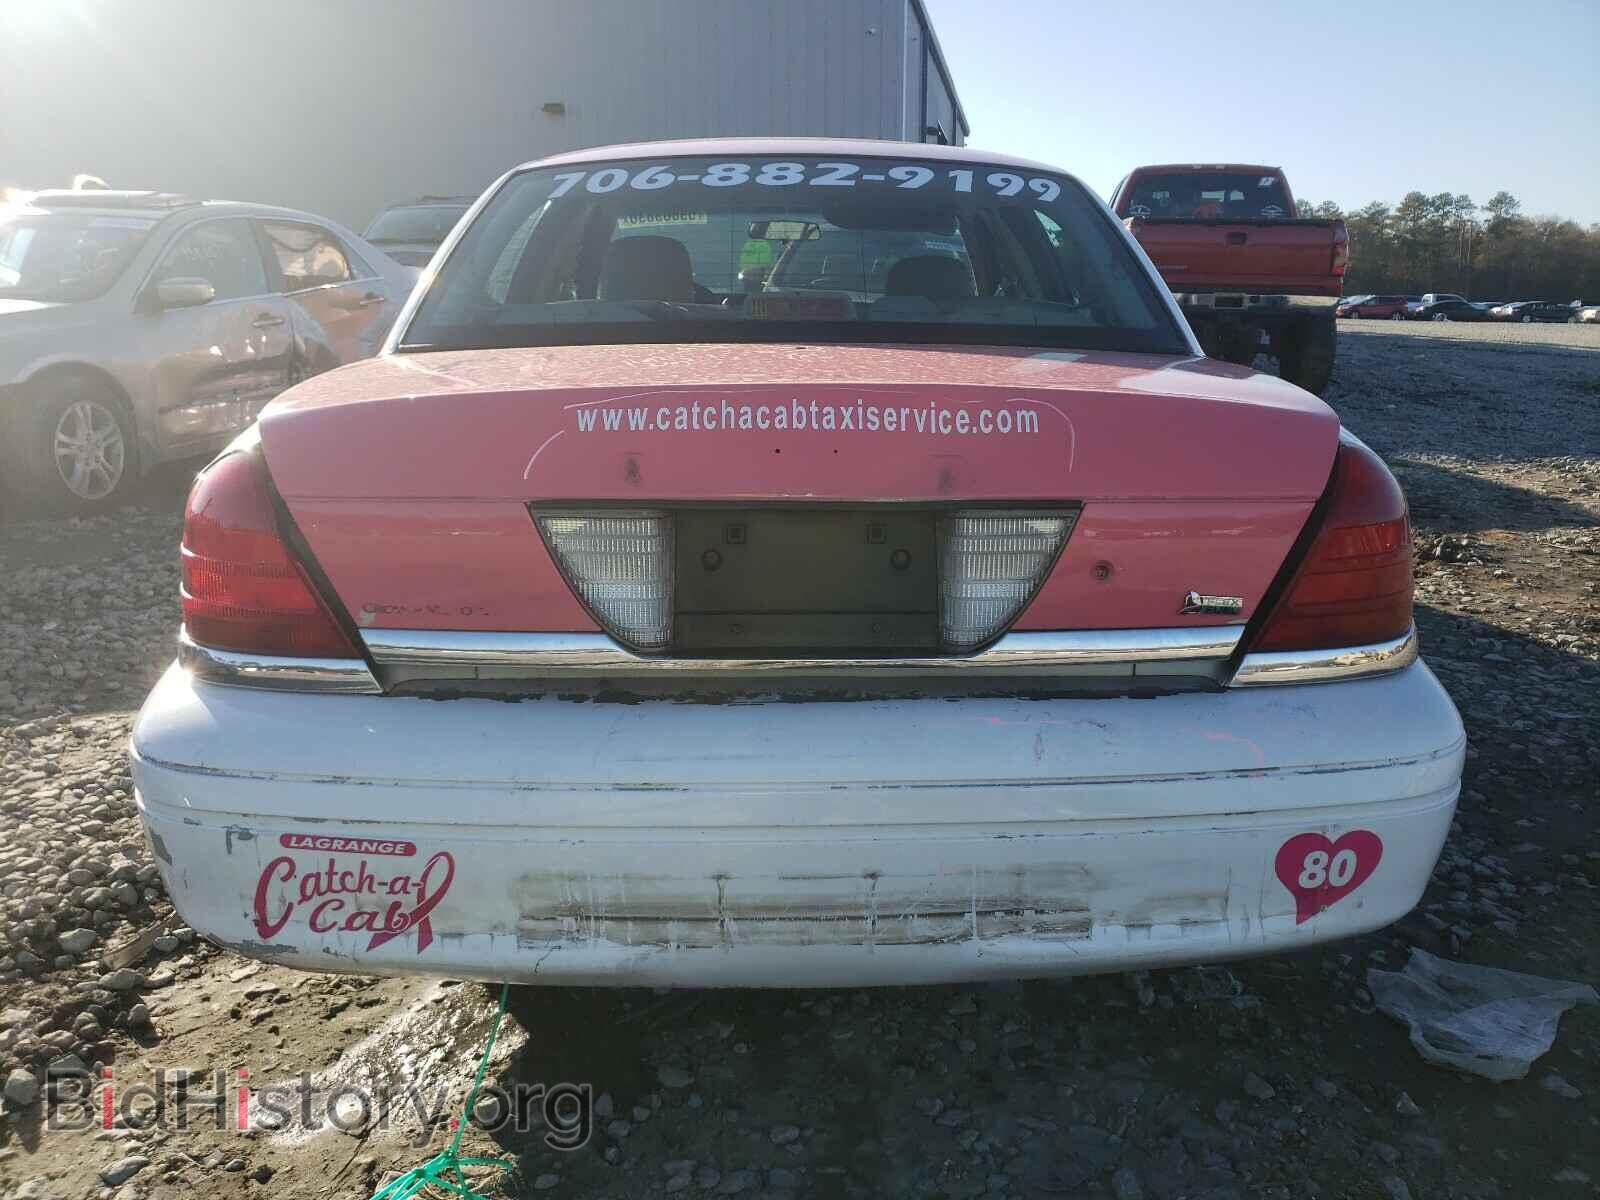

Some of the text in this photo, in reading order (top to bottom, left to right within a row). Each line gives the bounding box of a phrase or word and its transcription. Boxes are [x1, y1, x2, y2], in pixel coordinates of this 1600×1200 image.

[547, 161, 1062, 202] 706-882-9199
[576, 399, 1040, 435] www.catchacabtaxiservice.com
[289, 835, 407, 855] LAGRANGE
[1298, 848, 1357, 889] 80
[308, 898, 413, 934] Cab
